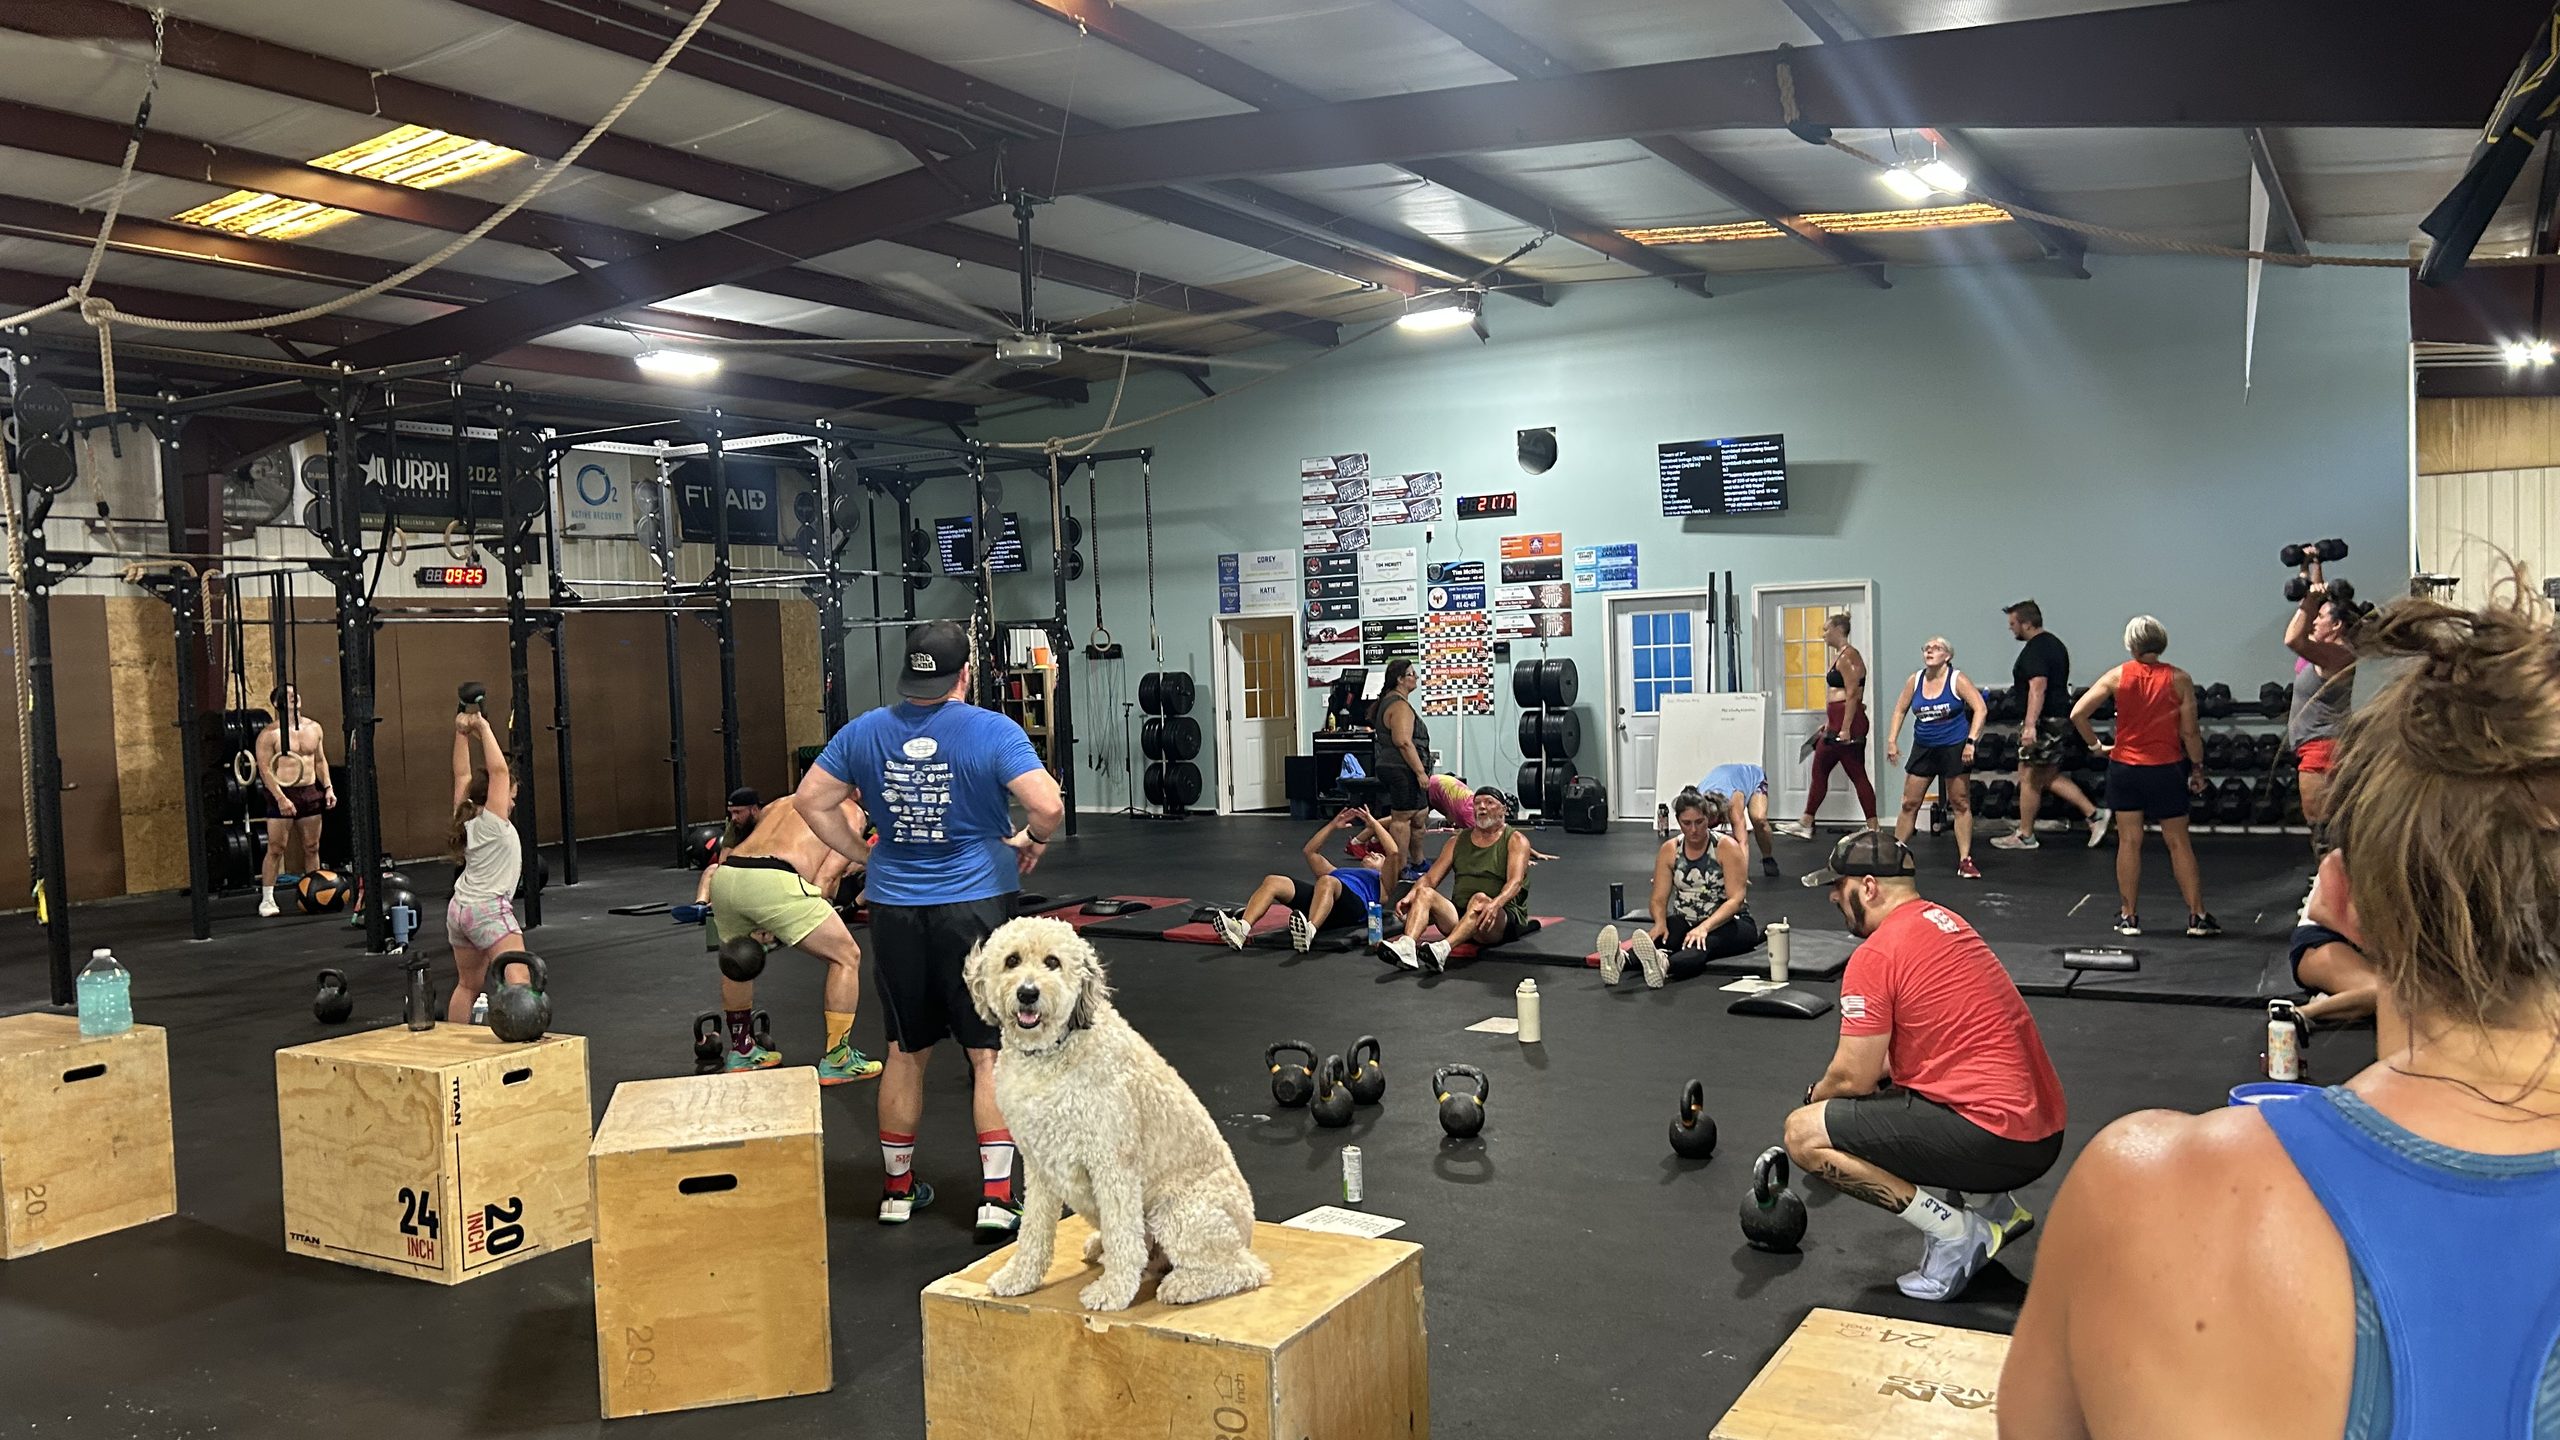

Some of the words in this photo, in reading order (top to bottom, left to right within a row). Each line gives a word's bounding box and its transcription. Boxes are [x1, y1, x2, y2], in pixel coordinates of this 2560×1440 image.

[468, 465, 501, 482] 202
[685, 484, 767, 511] FIAID
[571, 509, 591, 519] ACTIVE
[592, 511, 623, 521] RECOVERY
[1256, 555, 1276, 564] COREY
[445, 568, 483, 583] 09:25
[1259, 586, 1276, 594] KATIE
[452, 1076, 462, 1127] TITAN
[24, 1184, 47, 1216] 20
[398, 1187, 440, 1240] 24
[467, 1210, 485, 1254] INCH
[484, 1196, 525, 1256] 20
[289, 1232, 320, 1245] TITAN
[407, 1237, 435, 1261] INCH
[1879, 1329, 1936, 1349] 24
[1887, 1375, 1995, 1400] NESS
[1213, 1406, 1248, 1440] 0
